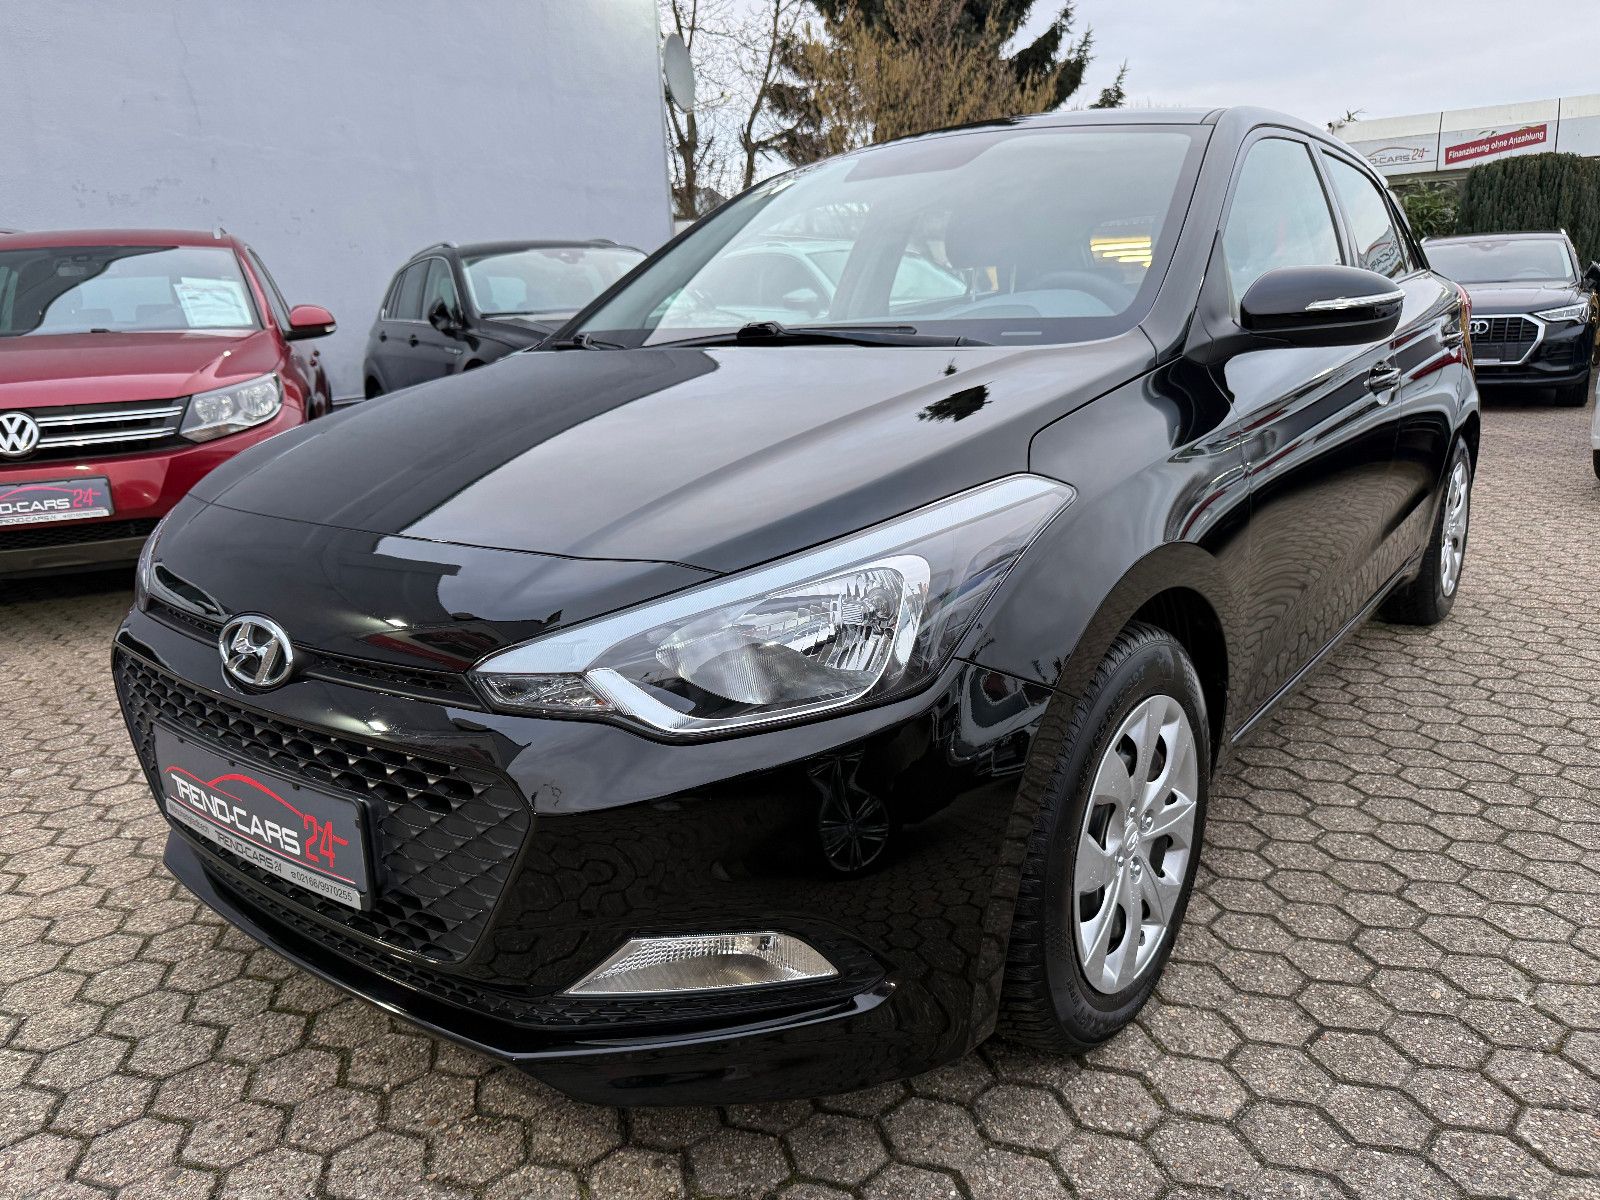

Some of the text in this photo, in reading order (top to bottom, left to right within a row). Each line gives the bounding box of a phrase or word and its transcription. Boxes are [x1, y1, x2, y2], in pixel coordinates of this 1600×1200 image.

[1448, 131, 1544, 160] Finanzierung ohne Anzahlung
[73, 487, 94, 508] 24
[171, 773, 300, 856] TREND-CARS
[303, 814, 336, 868] 24
[214, 829, 274, 870] TREND-CARS
